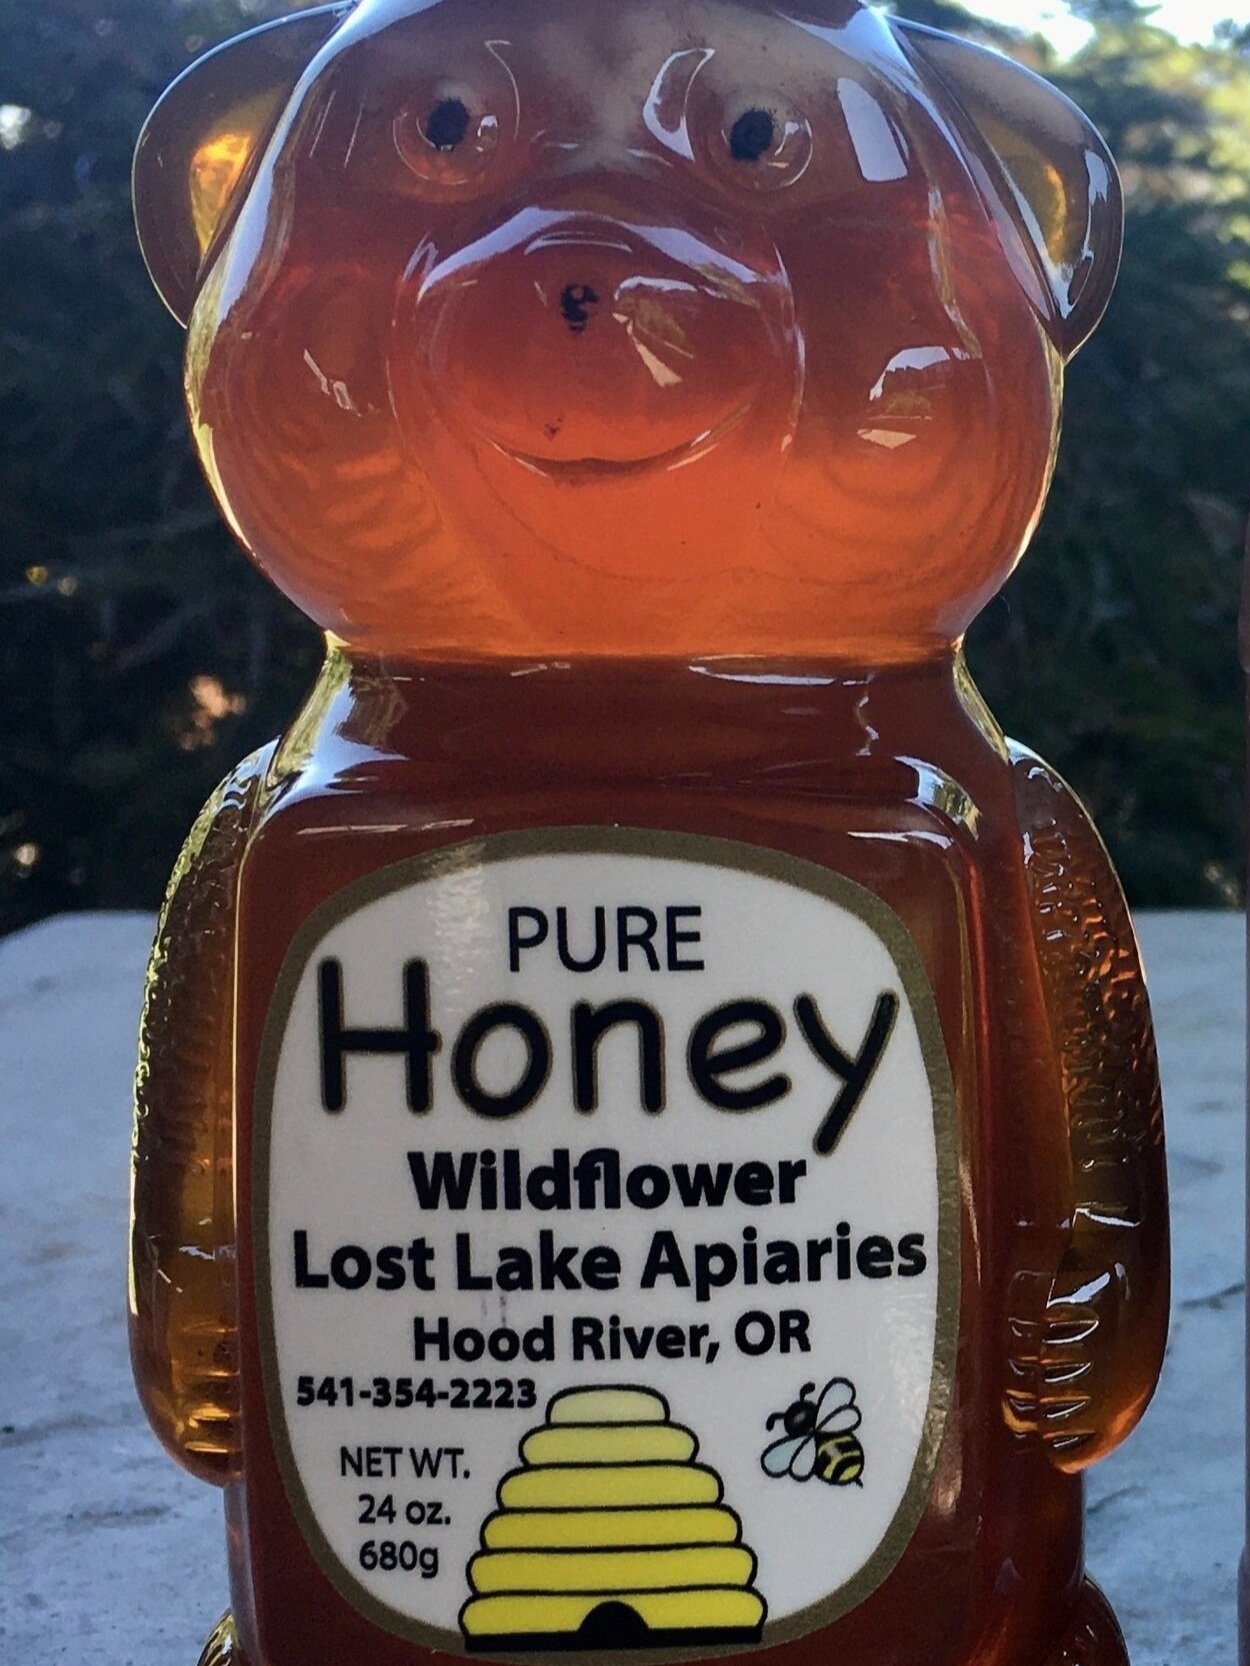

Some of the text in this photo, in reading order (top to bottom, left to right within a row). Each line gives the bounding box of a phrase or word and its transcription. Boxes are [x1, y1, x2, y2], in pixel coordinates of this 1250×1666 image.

[507, 905, 705, 973] PURE
[316, 955, 899, 1157] Honey
[406, 1147, 807, 1212] Wildflower
[292, 1221, 927, 1303] Lost Lake Apiaries
[413, 1309, 812, 1365] Hood River, OR
[296, 1375, 538, 1410] 541-354-2223
[339, 1445, 471, 1480] NET WT.
[358, 1493, 452, 1526] 24 oz.
[358, 1539, 439, 1580] 680g
